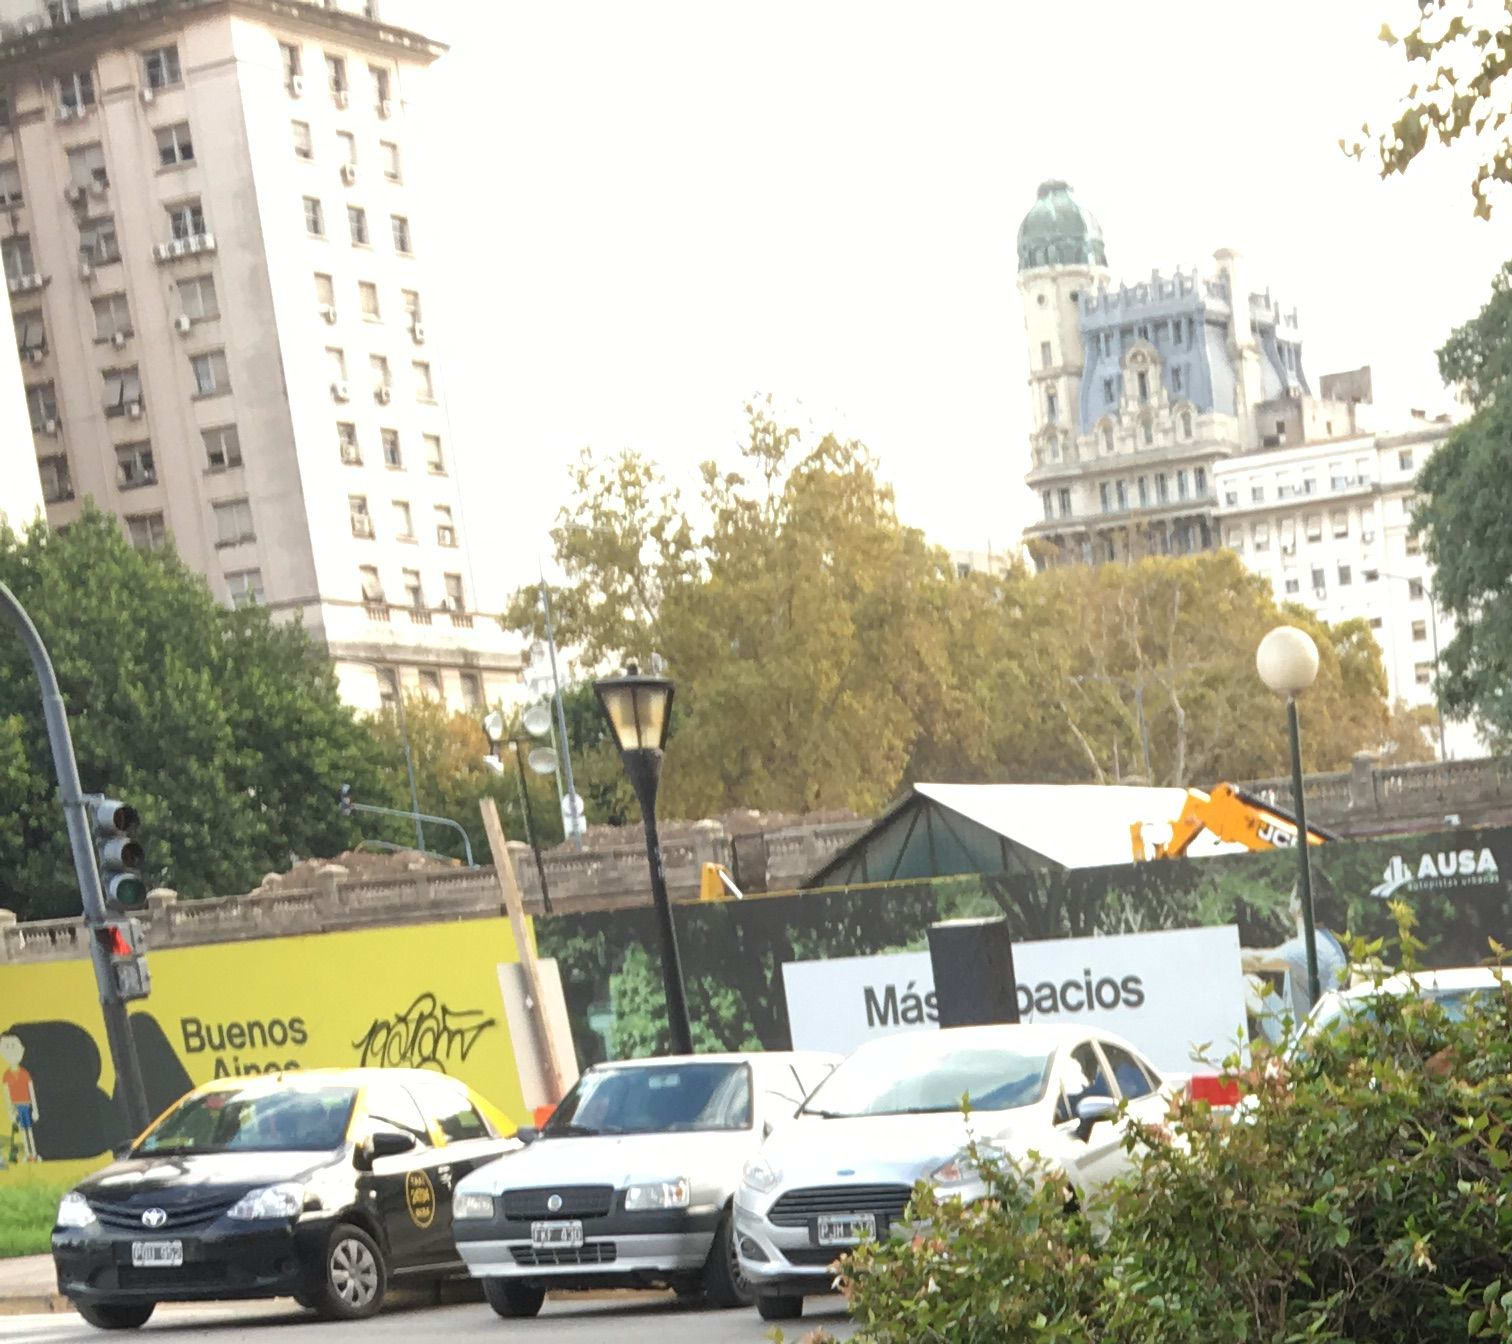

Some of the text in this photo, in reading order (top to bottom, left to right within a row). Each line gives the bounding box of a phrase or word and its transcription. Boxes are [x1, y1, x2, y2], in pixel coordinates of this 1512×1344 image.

[1417, 848, 1499, 880] AUSA
[863, 967, 1146, 1027] Más pacios
[180, 1016, 308, 1054] Buenos
